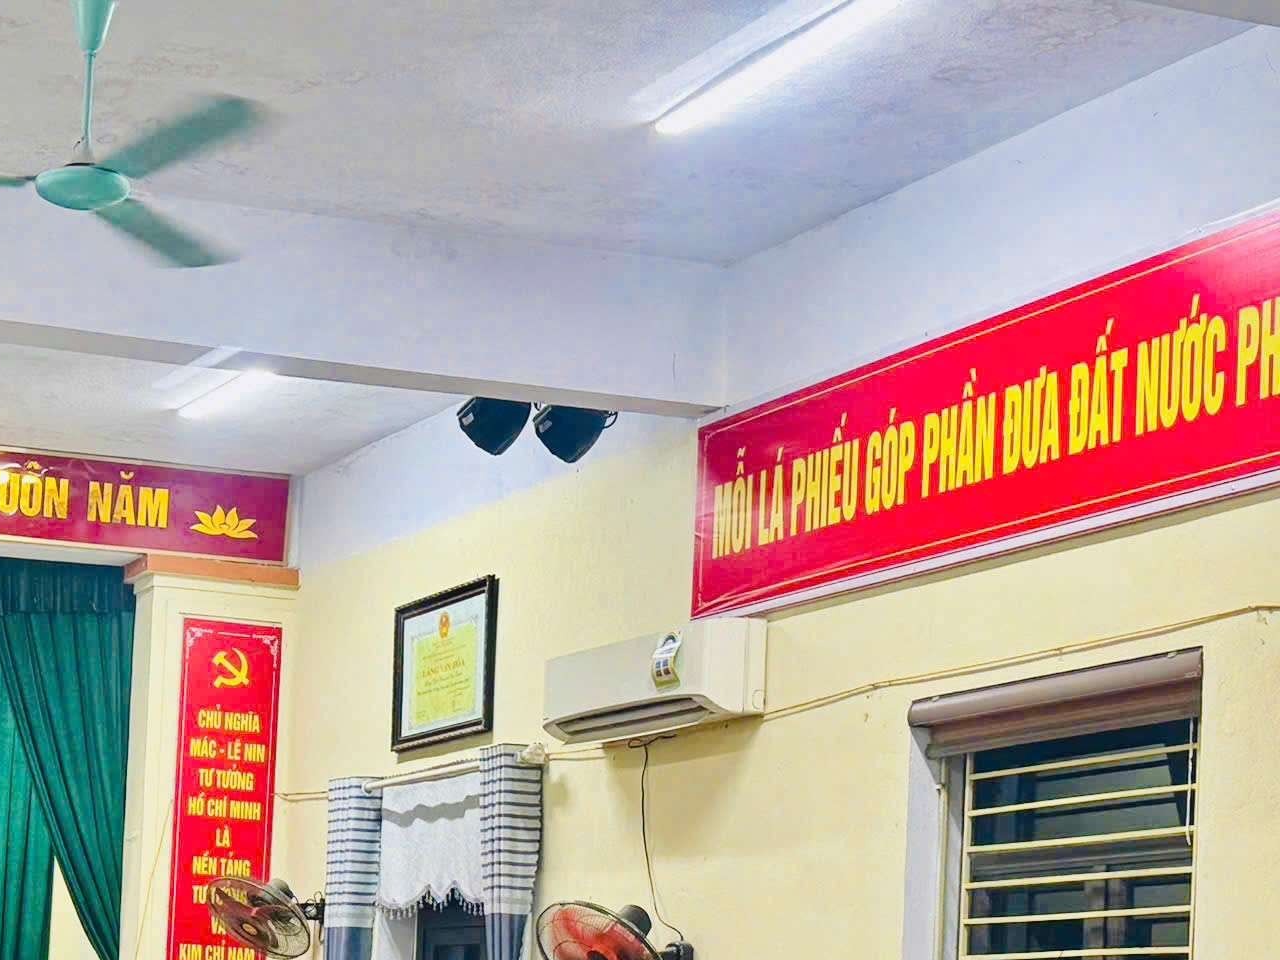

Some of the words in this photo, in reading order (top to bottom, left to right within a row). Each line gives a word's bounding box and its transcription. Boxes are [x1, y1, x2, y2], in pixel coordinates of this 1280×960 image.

[713, 448, 754, 560] MỖI
[758, 447, 784, 546] LÁ
[790, 412, 860, 537] PHIẾU
[866, 408, 915, 515] GÓP
[921, 368, 996, 499] PHẦN
[1002, 365, 1059, 475] ĐƯA
[1068, 318, 1129, 457] ĐẤT
[1136, 294, 1227, 436] NƯỚC
[87, 471, 169, 528] NĂM
[198, 704, 221, 729] CHỦ
[224, 712, 260, 733] NGHĨA
[190, 735, 216, 758] MÁC
[244, 744, 265, 762] NIN
[199, 768, 215, 786] TƯ
[216, 764, 254, 791] TƯỞNG
[188, 791, 205, 815] HỒ
[207, 796, 227, 817] CHÍ
[230, 801, 261, 820] MINH
[216, 825, 230, 847] LÀ
[193, 851, 216, 876] NỀN
[220, 851, 250, 877] TẢNG
